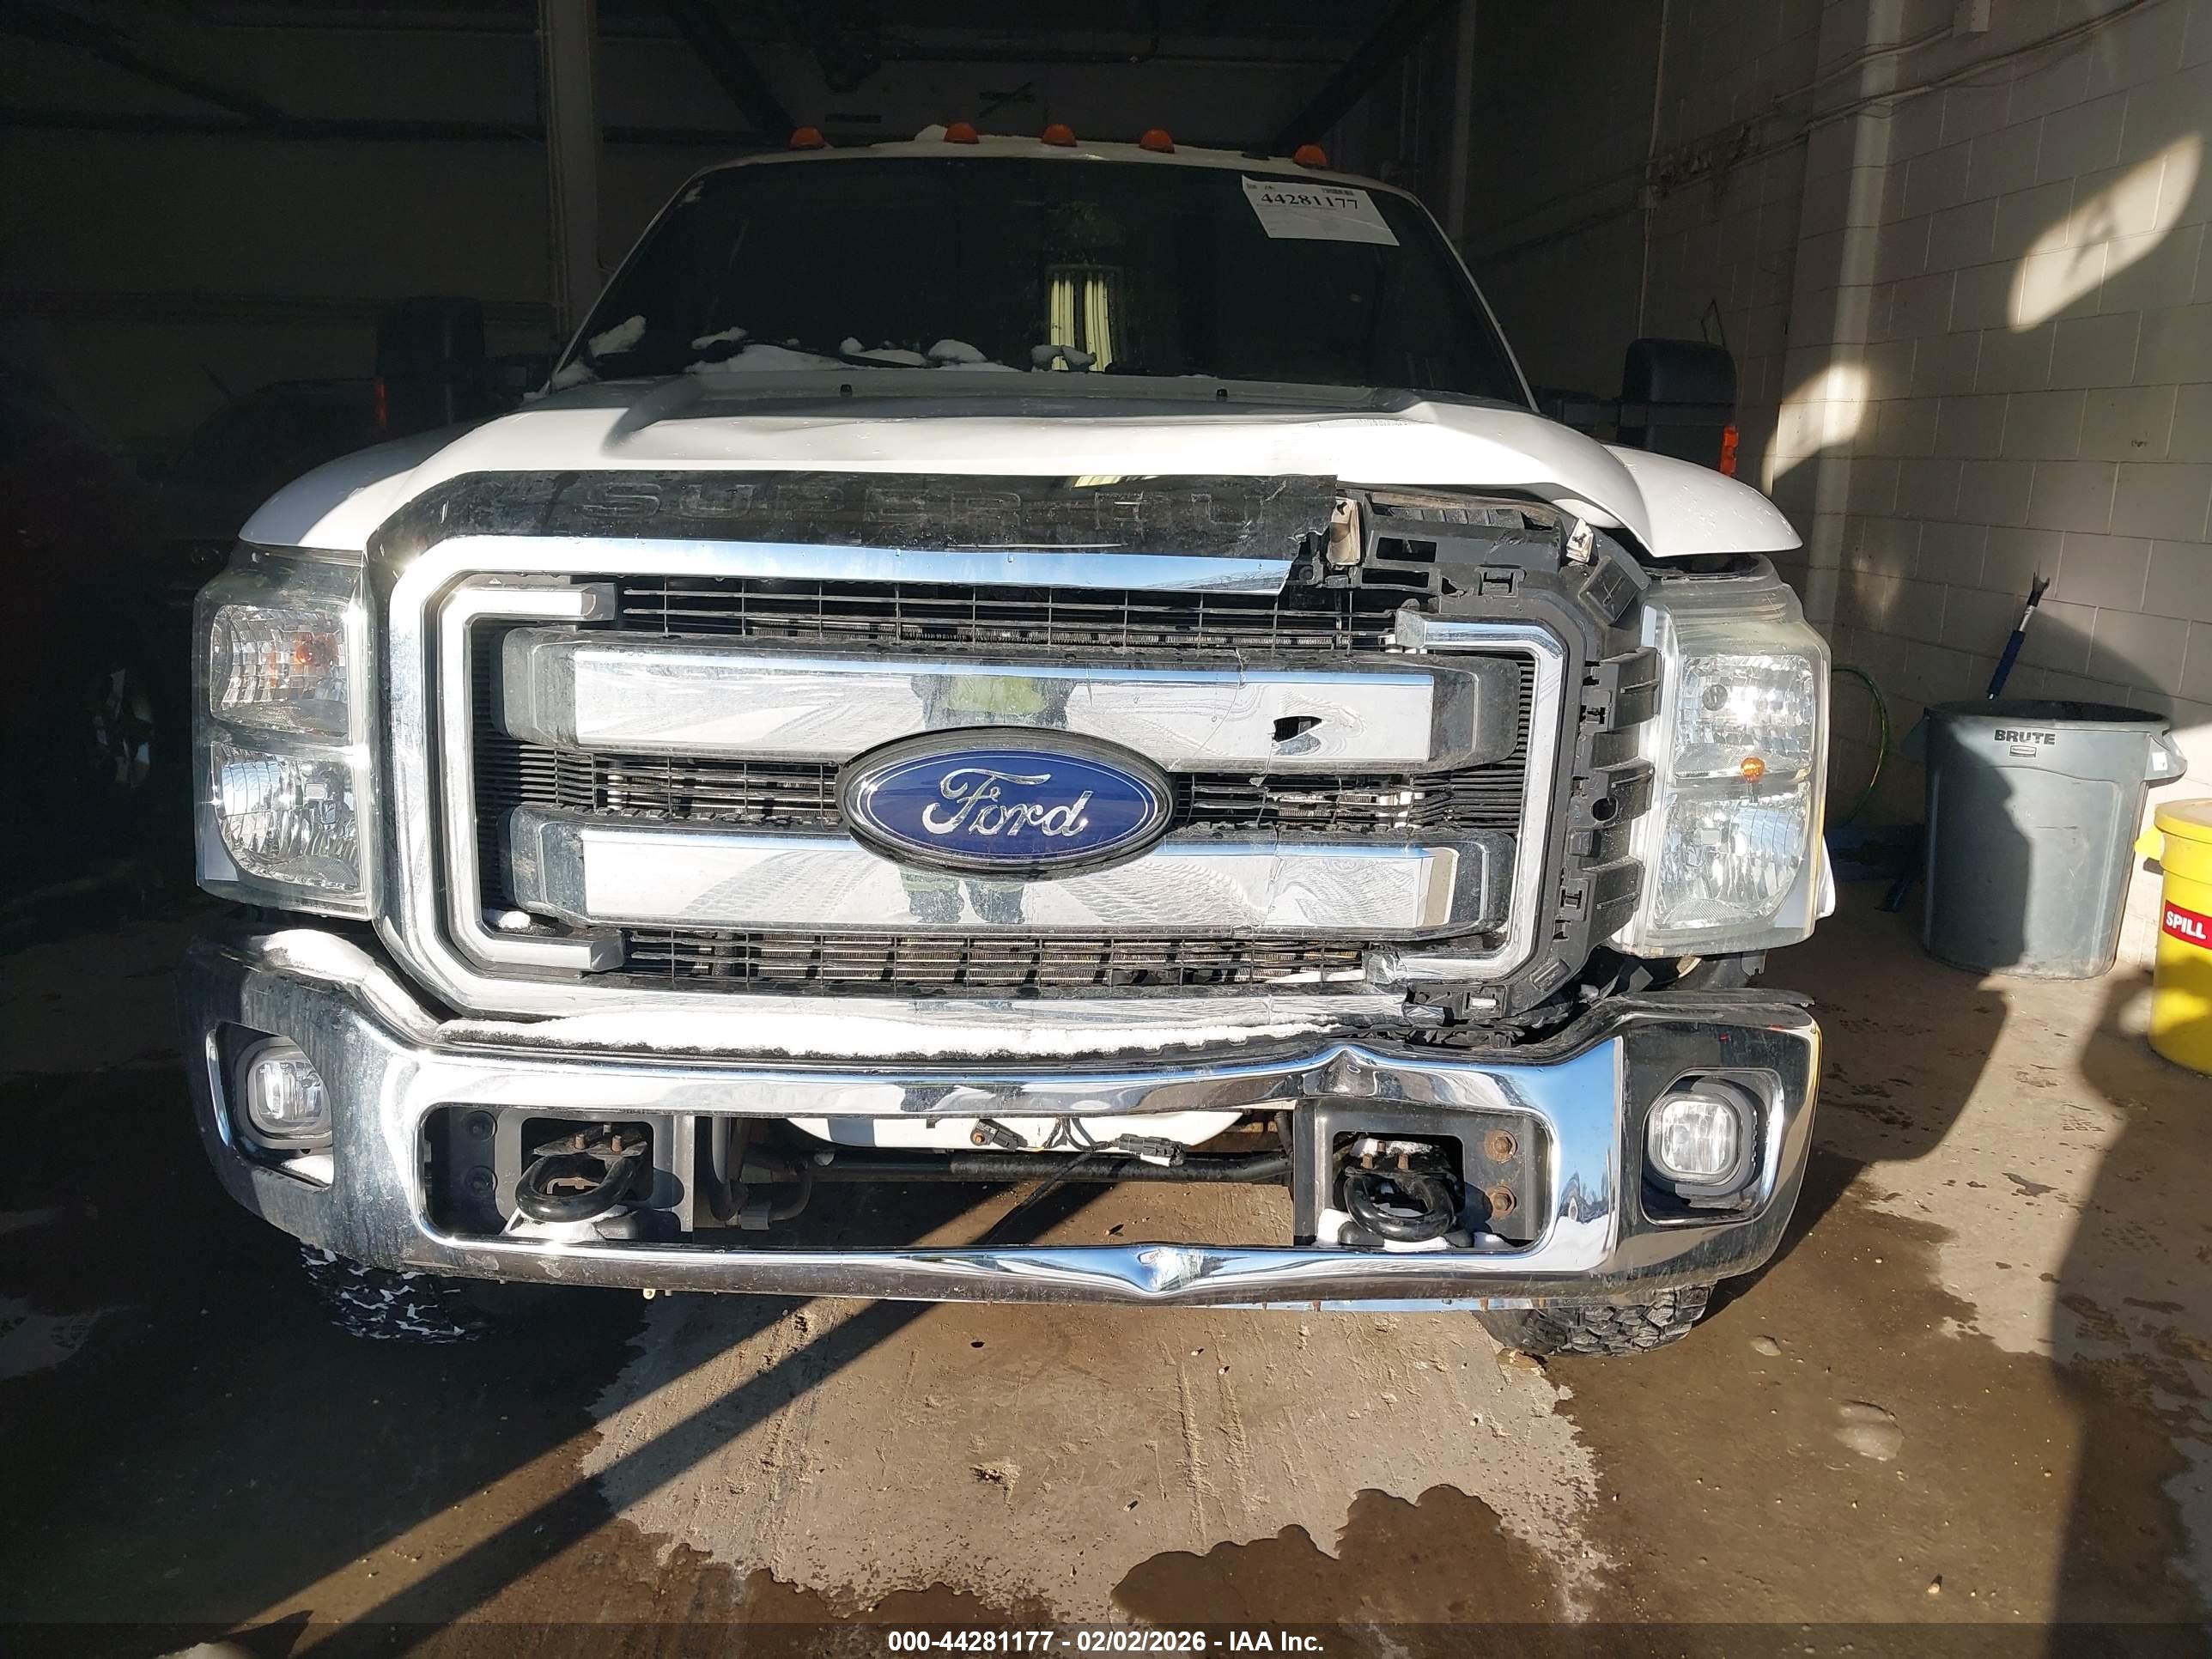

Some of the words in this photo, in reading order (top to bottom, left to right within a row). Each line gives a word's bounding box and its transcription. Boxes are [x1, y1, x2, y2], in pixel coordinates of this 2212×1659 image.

[1261, 193, 1358, 210] 44281177
[581, 481, 1023, 527] SUPER
[1994, 729, 2056, 745] BRUTE
[921, 768, 1094, 837] Ford
[2166, 910, 2207, 940] SPILL
